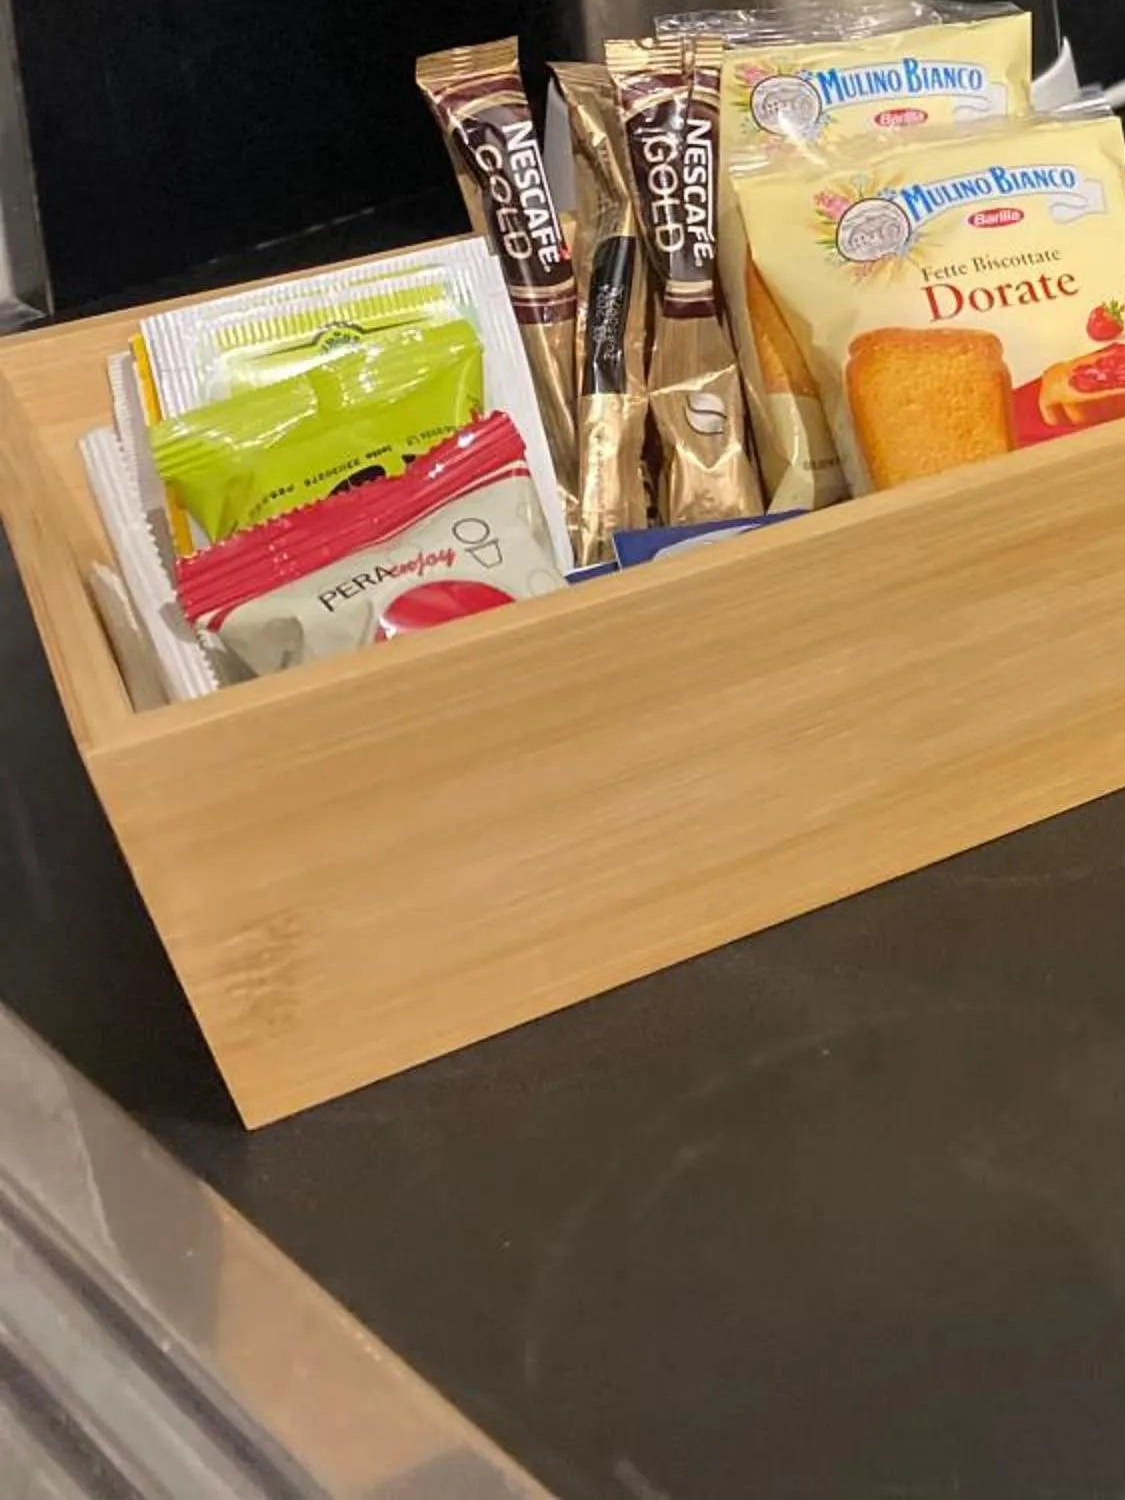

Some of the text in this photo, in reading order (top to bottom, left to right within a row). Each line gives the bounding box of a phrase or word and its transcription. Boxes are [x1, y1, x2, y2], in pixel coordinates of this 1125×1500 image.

[816, 57, 984, 105] MULINO BIANCO
[474, 144, 533, 260] GOLD
[642, 135, 685, 253] GOLD
[901, 166, 1077, 222] MULINO BIANCO
[974, 209, 1021, 226] Barilla
[921, 249, 1062, 283] Fette Biscottate
[920, 272, 1081, 323] Dorate
